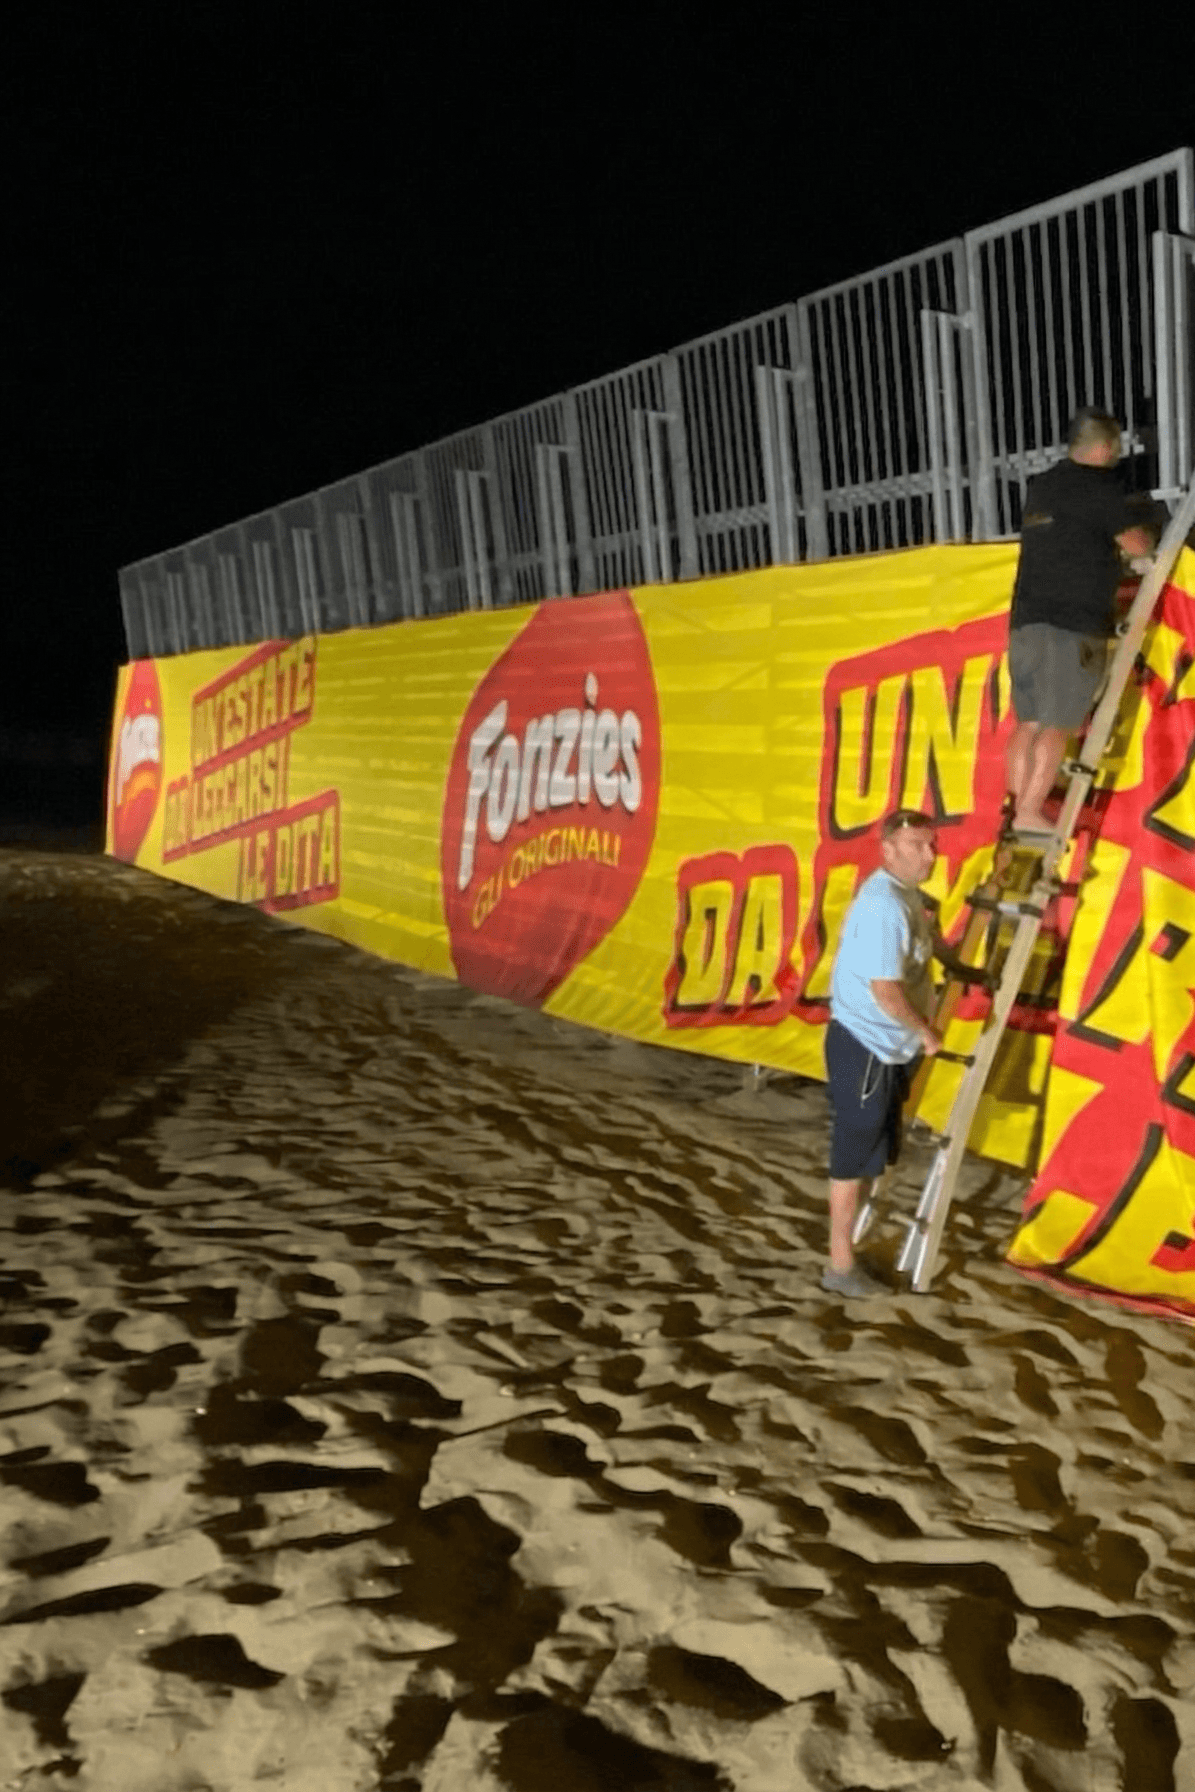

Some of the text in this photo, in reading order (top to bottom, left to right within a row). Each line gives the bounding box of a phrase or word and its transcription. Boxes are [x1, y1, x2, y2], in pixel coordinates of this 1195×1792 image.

[458, 671, 642, 892] Fonzies
[507, 822, 622, 890] ORIGINALI
[672, 870, 783, 1010] DA
